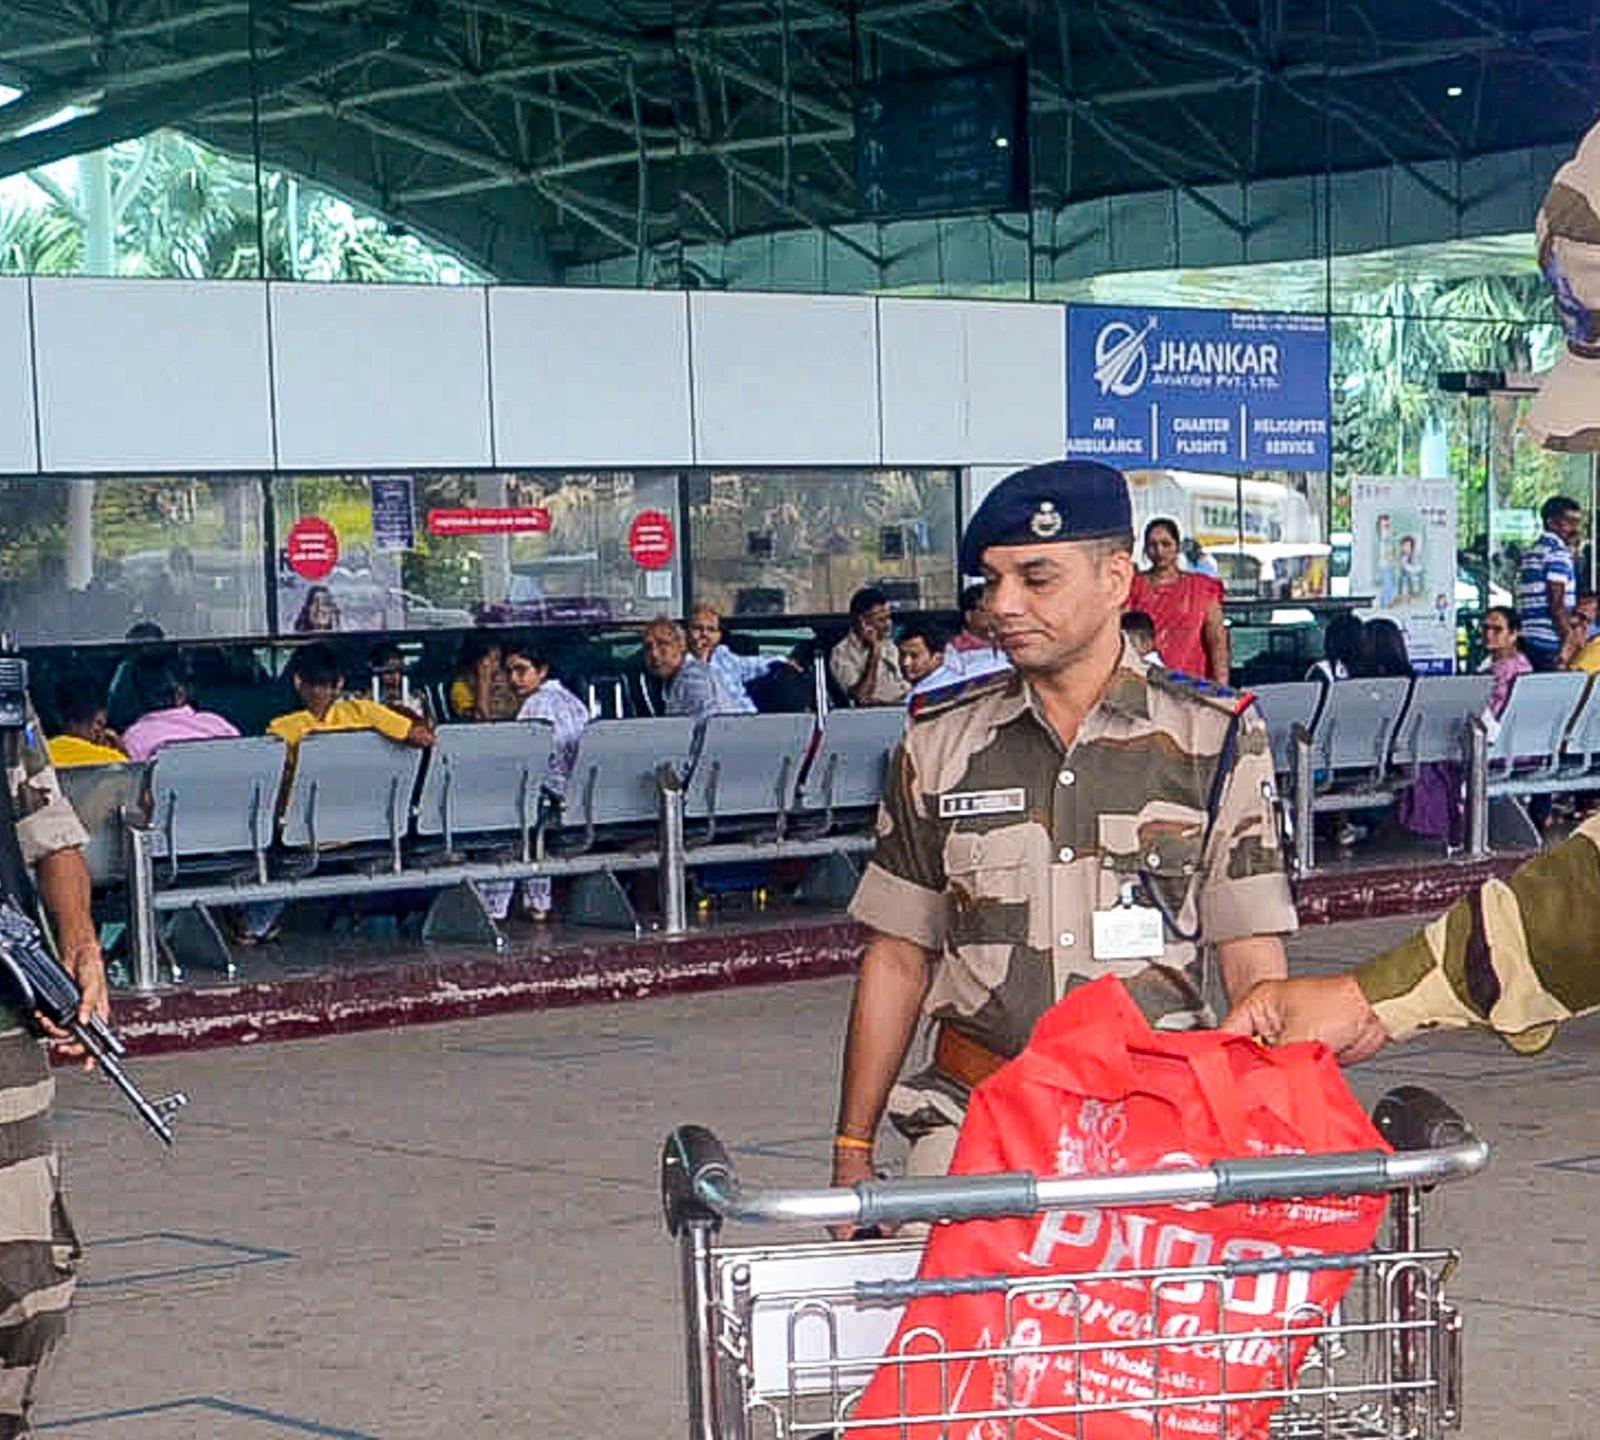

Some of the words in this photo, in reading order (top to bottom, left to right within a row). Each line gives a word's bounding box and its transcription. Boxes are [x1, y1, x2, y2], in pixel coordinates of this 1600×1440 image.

[1151, 341, 1278, 375] JHANKAR
[1093, 417, 1115, 432] AIR
[1173, 418, 1230, 433] CHARTER
[1254, 419, 1326, 434] HELICOPTER
[1176, 440, 1228, 454] FLIGHTS
[1265, 440, 1315, 455] SERVICE
